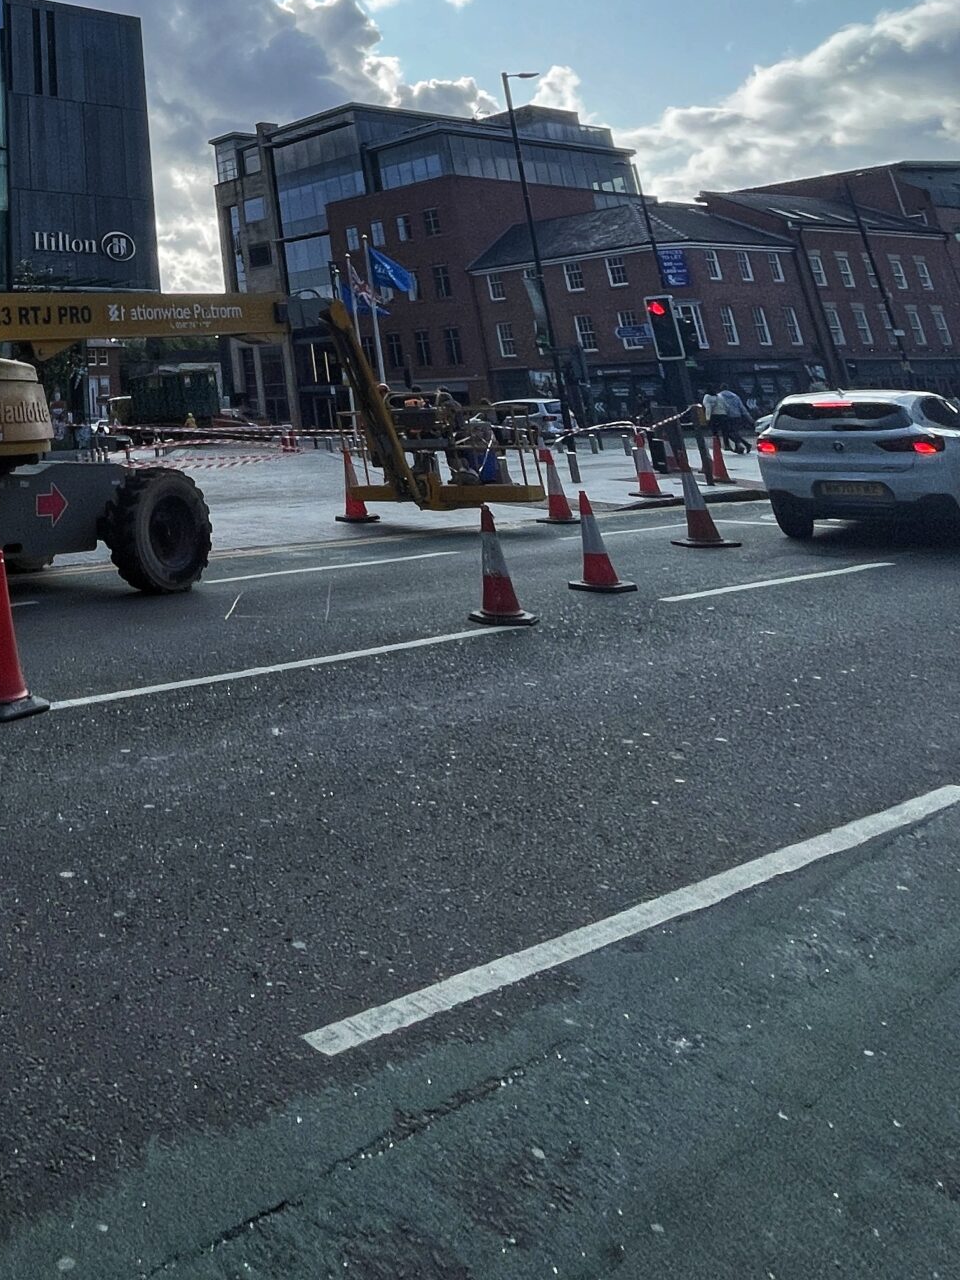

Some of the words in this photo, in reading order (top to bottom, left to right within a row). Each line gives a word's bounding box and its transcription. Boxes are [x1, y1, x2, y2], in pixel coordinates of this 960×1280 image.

[33, 231, 97, 253] Hilton
[17, 306, 51, 325] RTJ
[57, 305, 92, 324] PRO
